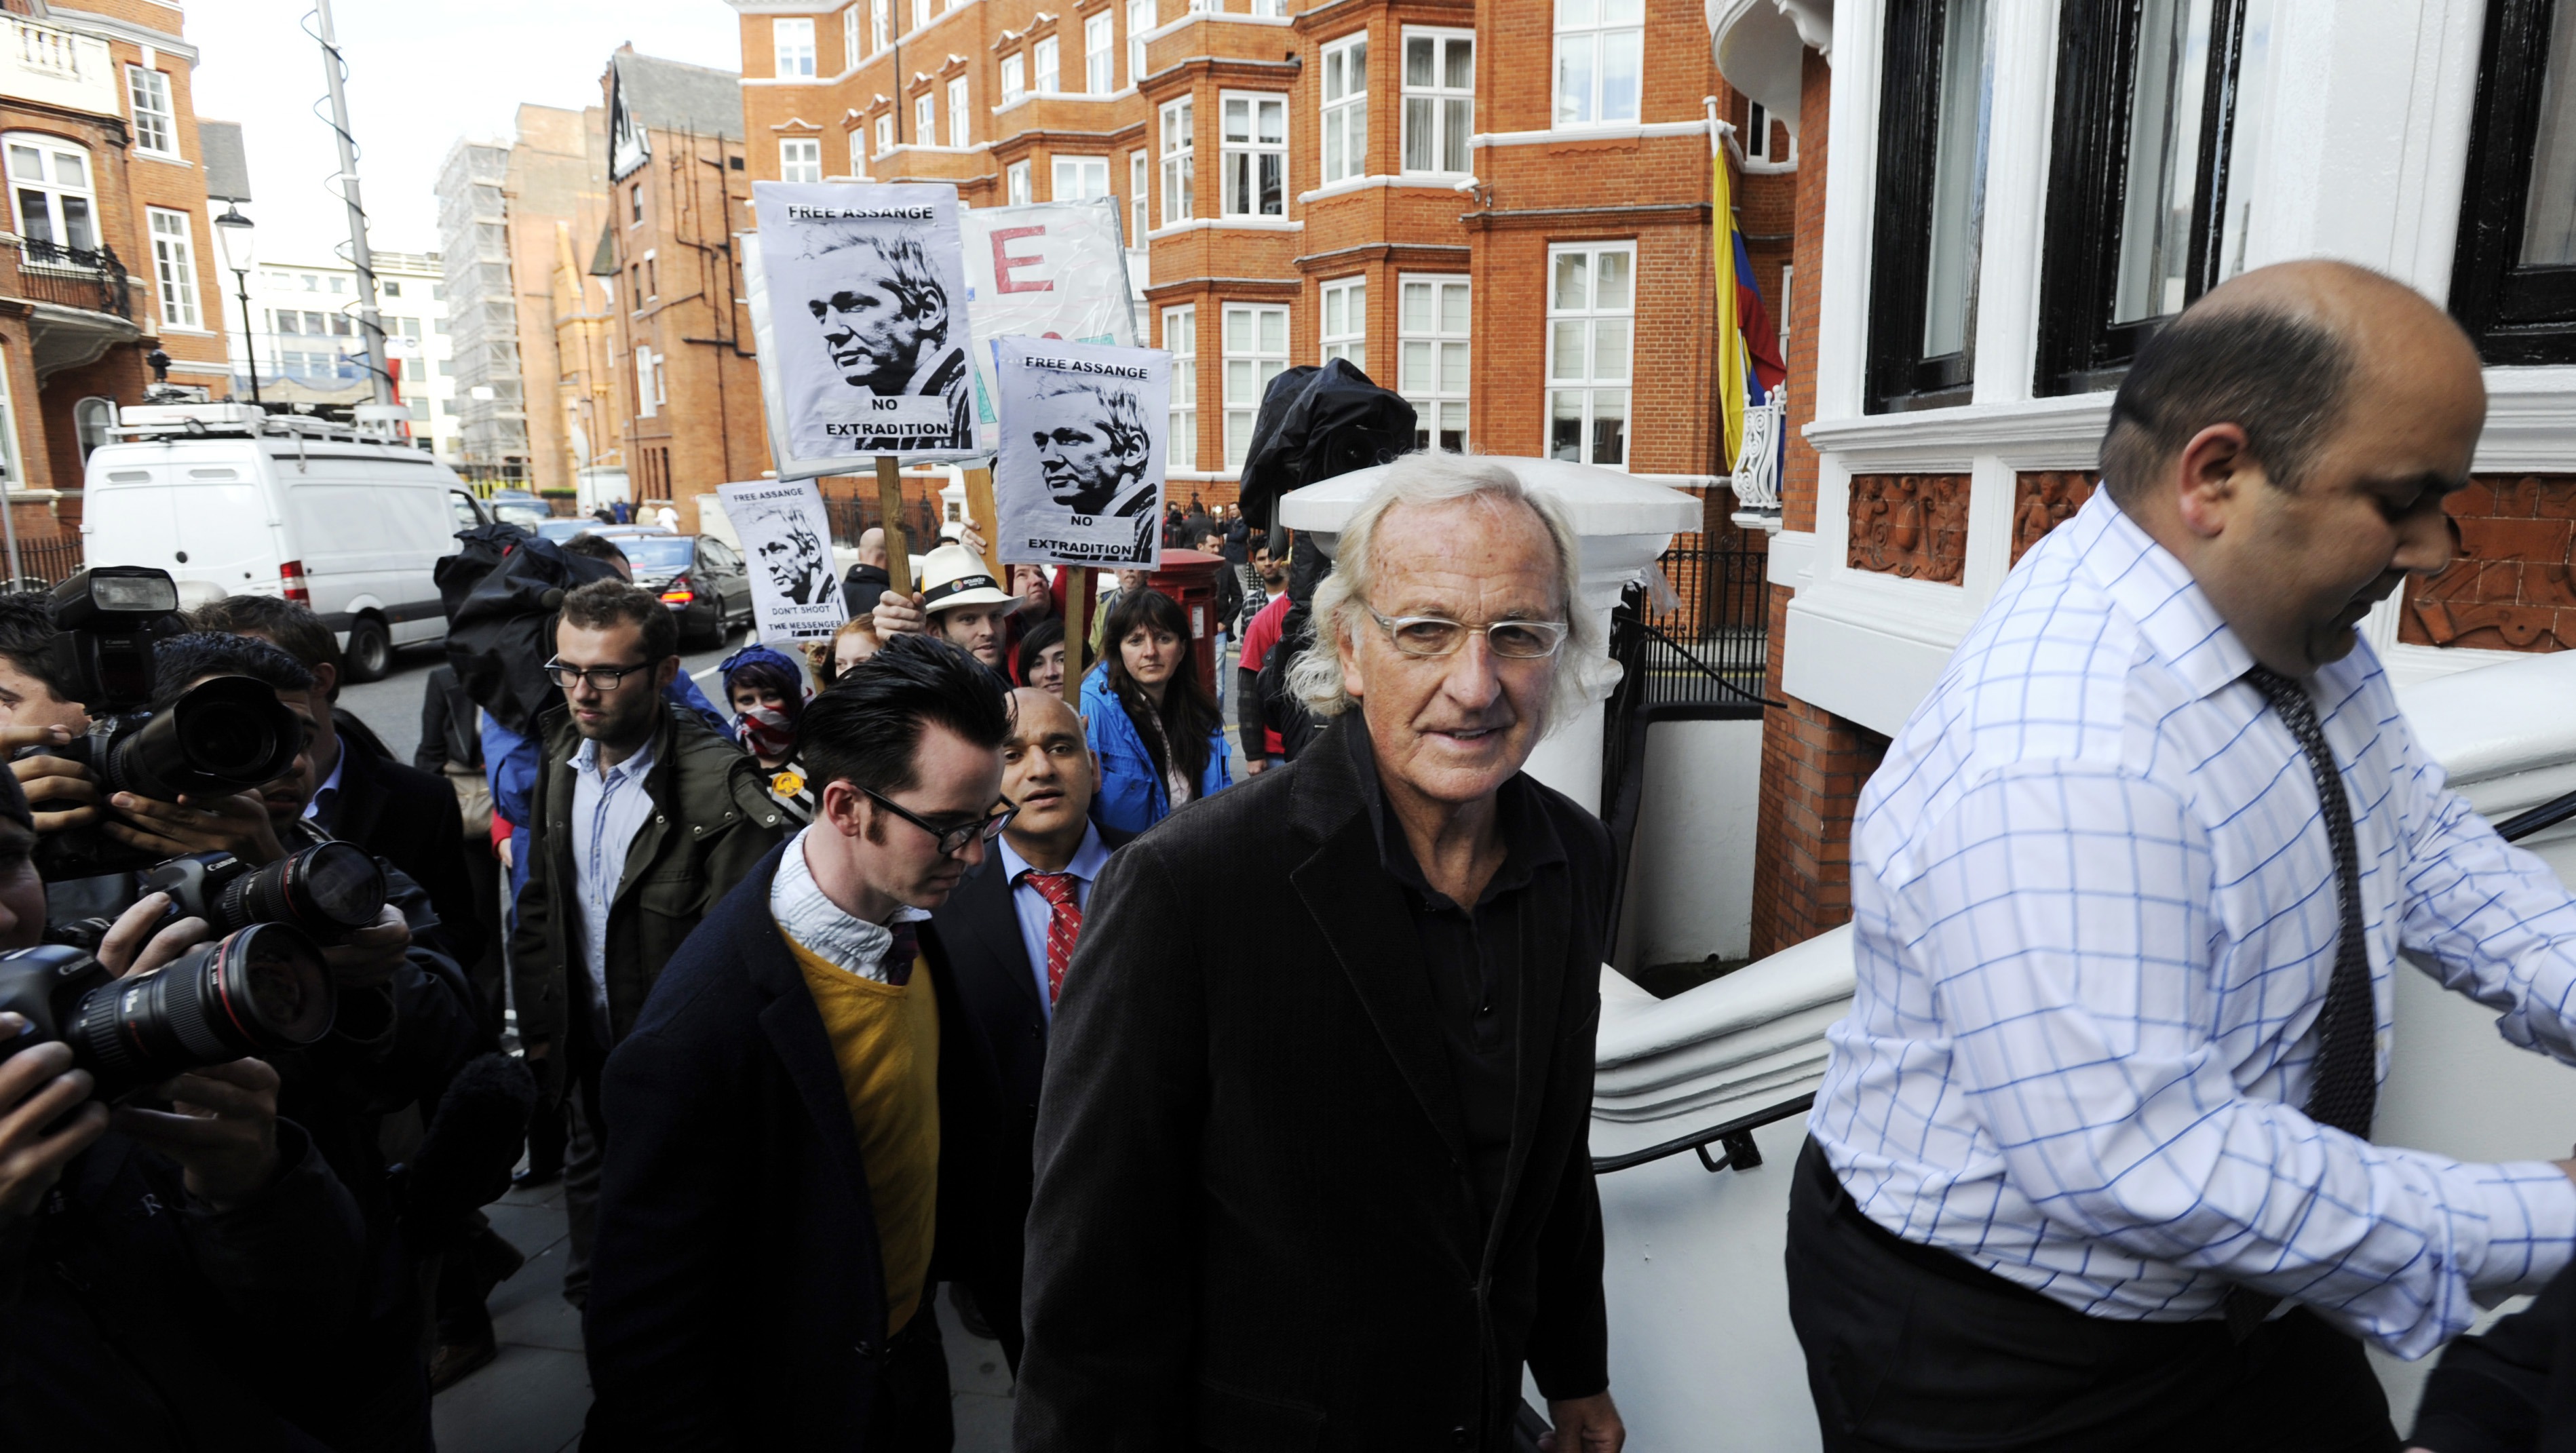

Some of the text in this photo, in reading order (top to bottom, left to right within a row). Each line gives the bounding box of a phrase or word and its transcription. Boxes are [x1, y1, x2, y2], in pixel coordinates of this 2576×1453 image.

[789, 206, 934, 219] FREE ASSANGE
[1026, 356, 1148, 379] FREE ASSANGE
[872, 398, 898, 410] NO
[826, 423, 948, 435] EXTRADITION
[733, 488, 804, 503] FREE ASSANGE
[1071, 516, 1093, 526] NO
[1029, 539, 1132, 556] EXTRADITION
[772, 605, 830, 615] DON'T SHOOT
[769, 620, 842, 631] THE MESSENGER
